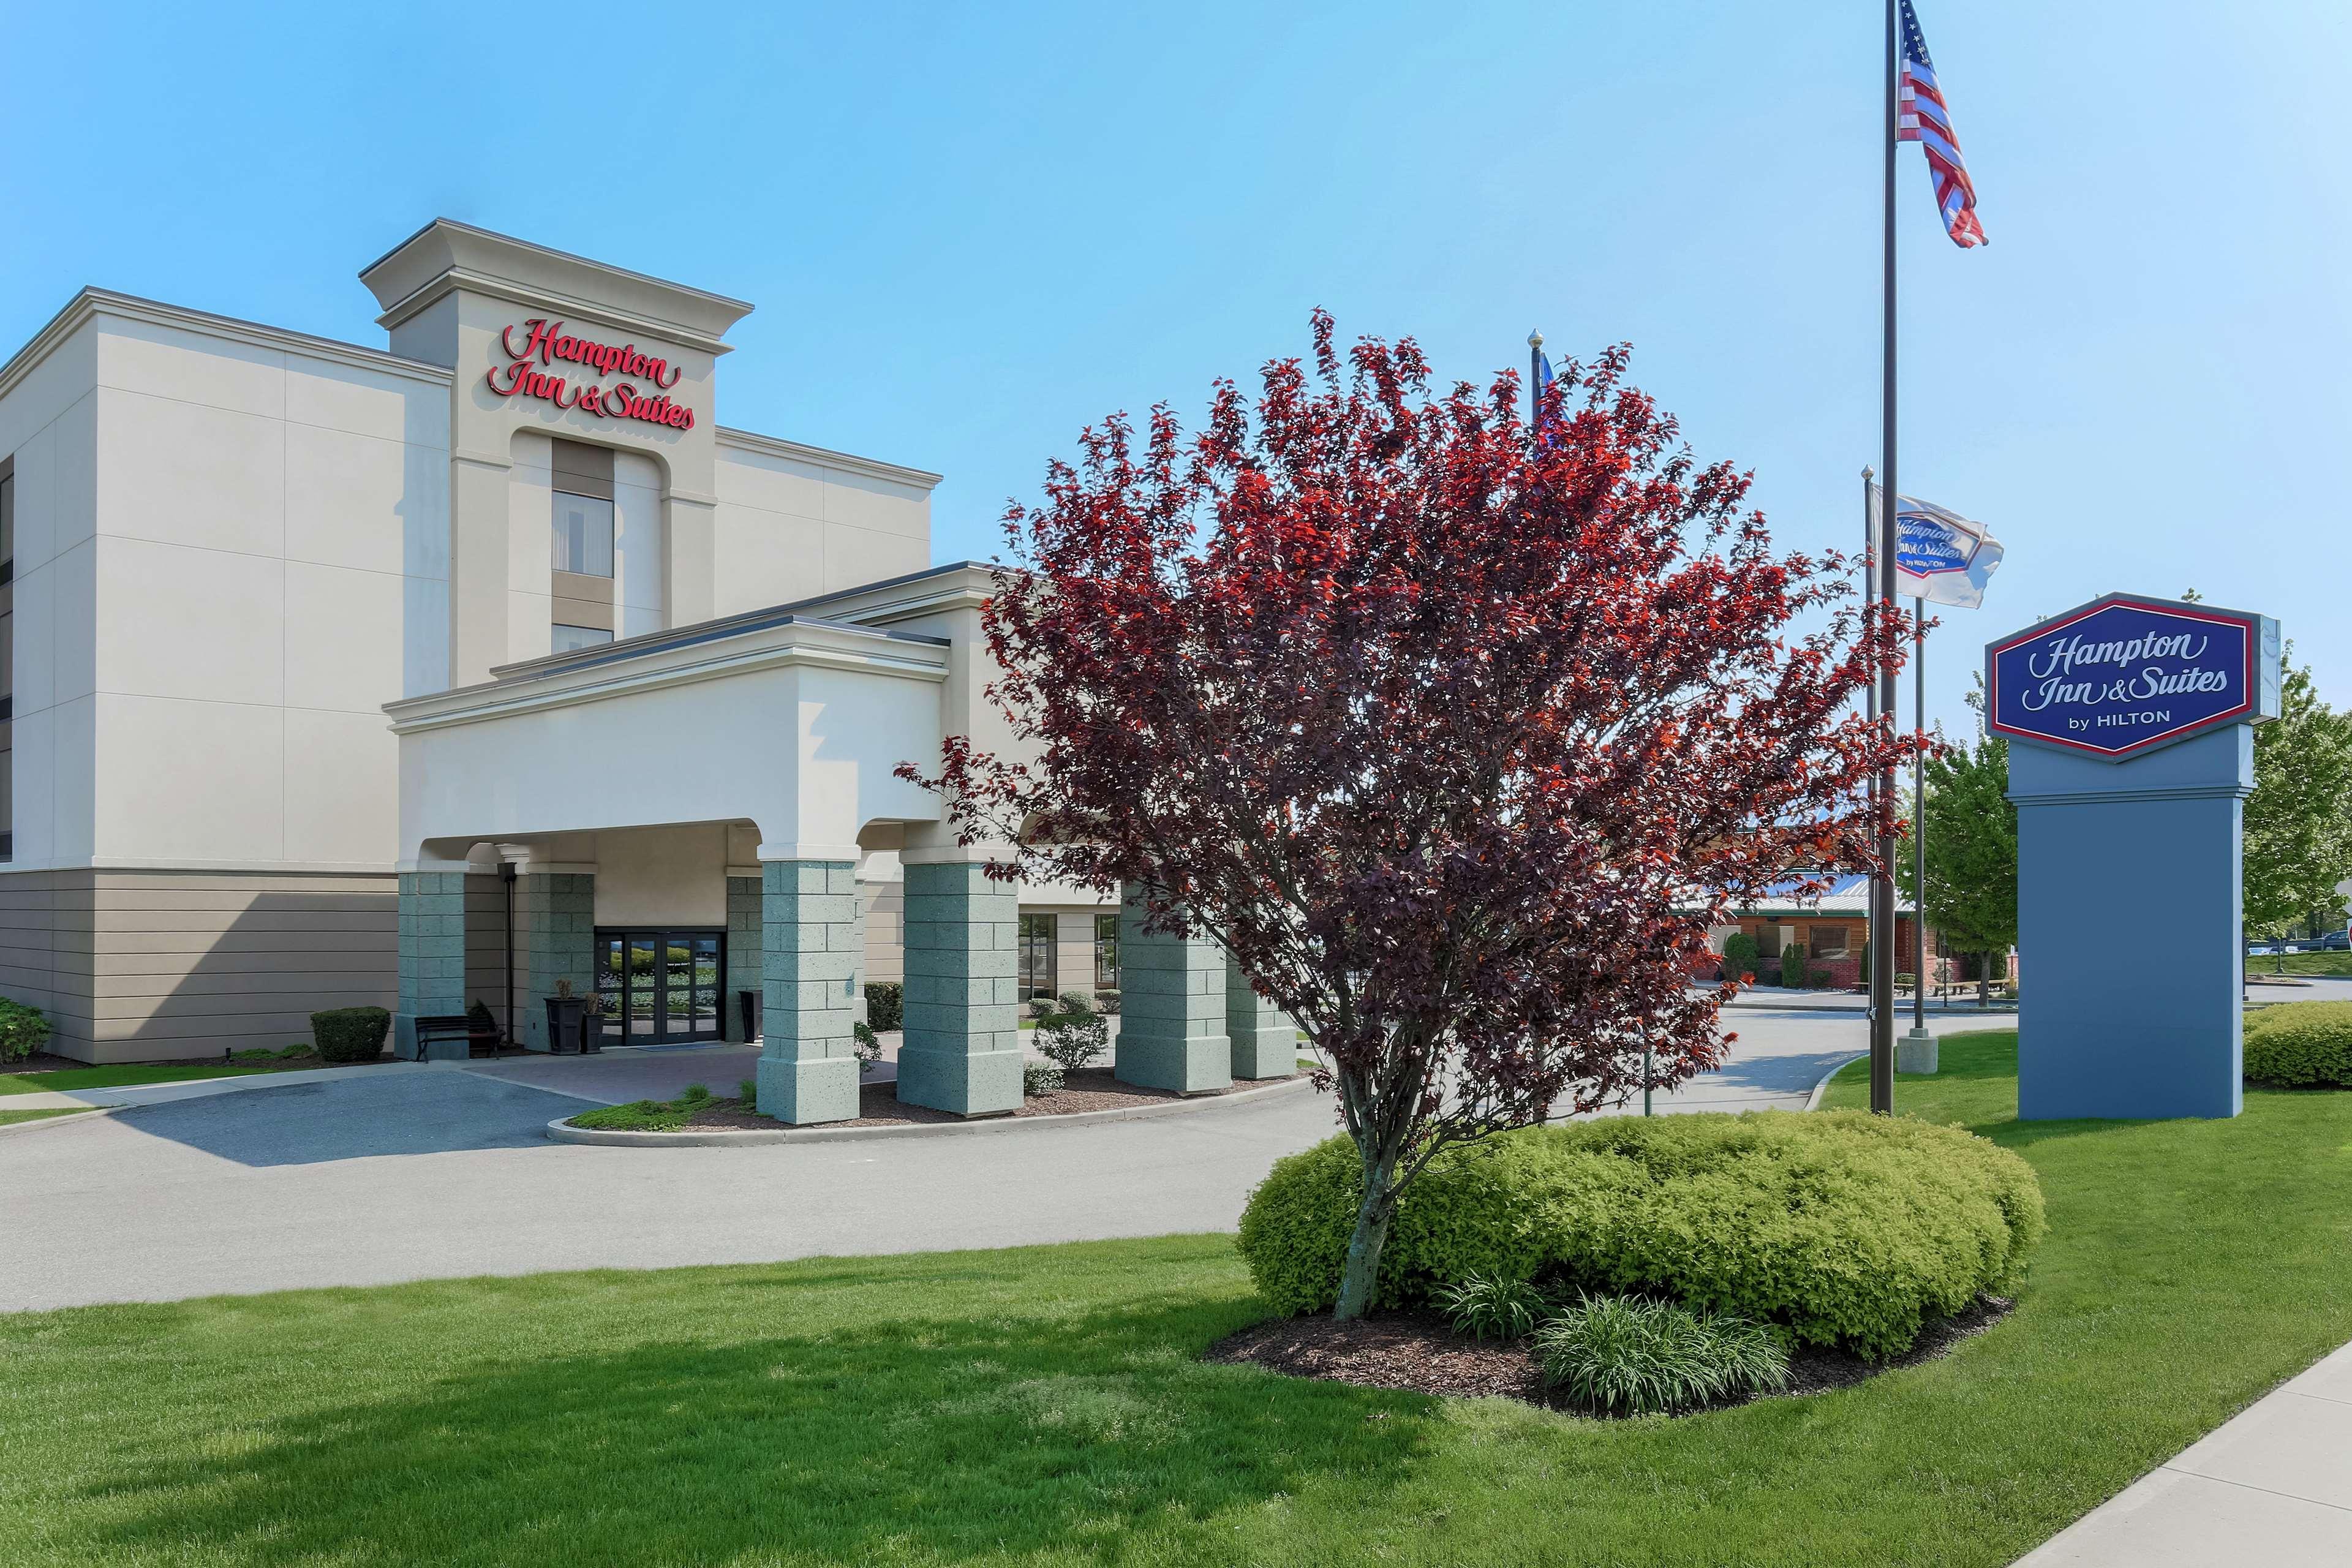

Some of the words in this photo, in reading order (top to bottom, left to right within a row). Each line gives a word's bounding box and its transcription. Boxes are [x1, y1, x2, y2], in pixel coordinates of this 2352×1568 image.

[502, 318, 681, 388] Hampton
[487, 361, 582, 409] Inn
[579, 385, 607, 418] &
[601, 382, 695, 430] Suites
[1918, 541, 1959, 559] Suites
[2029, 631, 2207, 678] Hampton
[2022, 676, 2106, 711] Inn
[2109, 679, 2131, 703] &
[2128, 666, 2228, 699] Suites
[2069, 718, 2090, 731] by
[2097, 710, 2170, 727] HILTON
